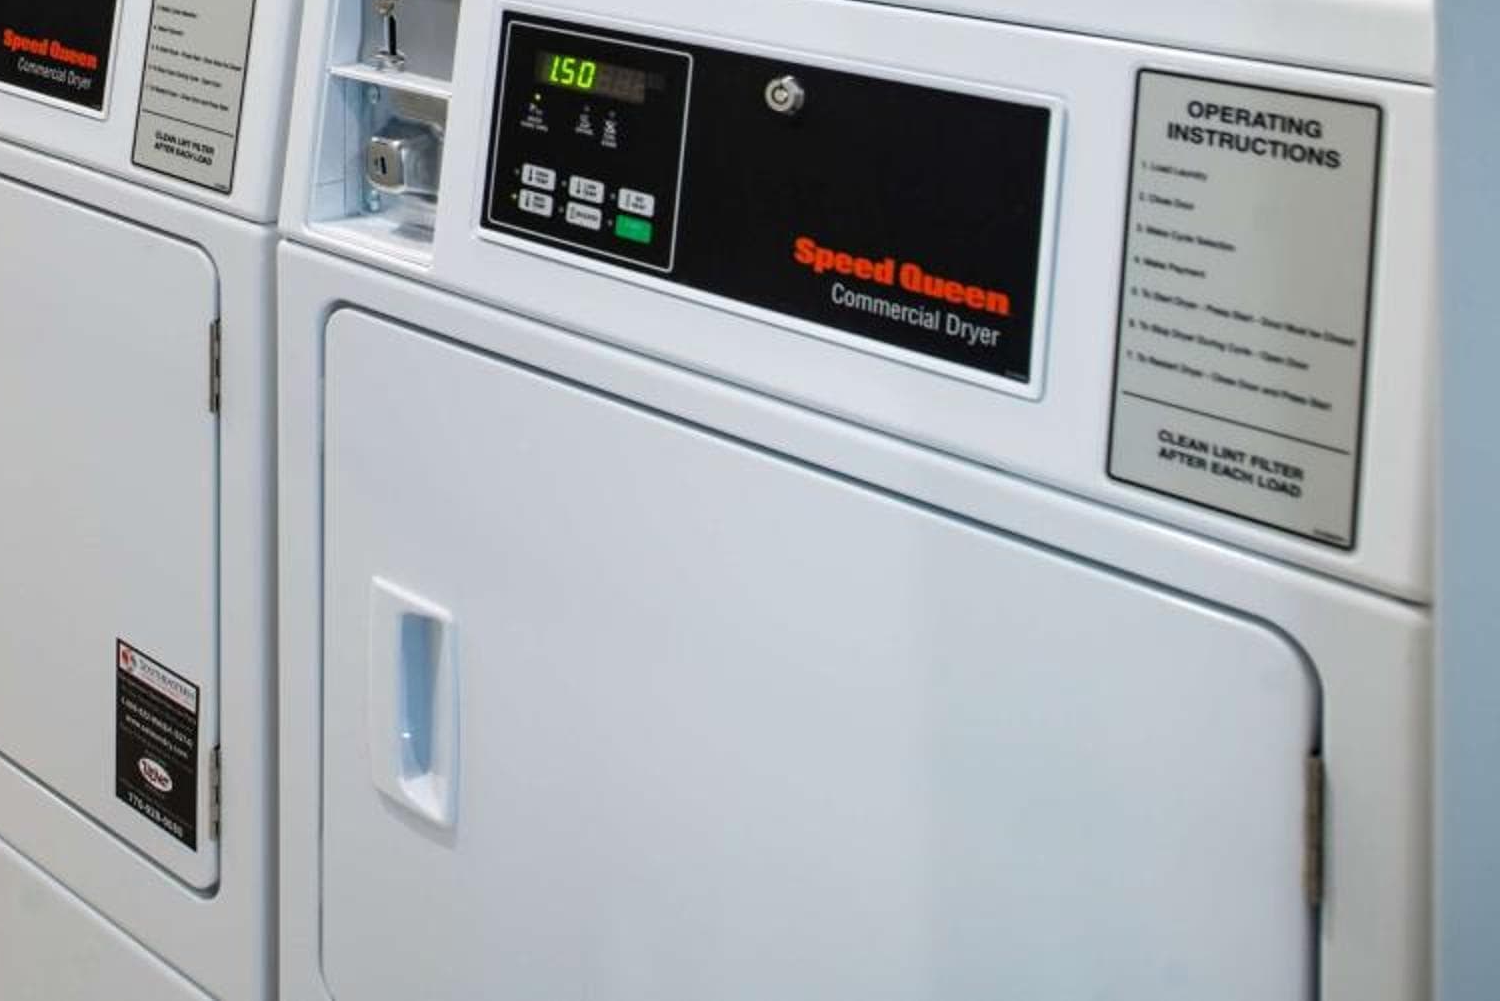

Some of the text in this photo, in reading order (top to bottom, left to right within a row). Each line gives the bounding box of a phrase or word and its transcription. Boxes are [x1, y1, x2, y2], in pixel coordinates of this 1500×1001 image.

[3, 29, 98, 70] Speed Queen
[17, 56, 67, 83] Commercial
[1187, 100, 1322, 139] OPERATING
[1166, 122, 1341, 169] INSTRUCTIONS
[793, 236, 1011, 316] Speed Queen
[831, 283, 1001, 346] Commercial Dryer
[1157, 428, 1303, 481] CLEAN LINT FILTER
[1158, 446, 1301, 498] AFTER EACH LOAD
